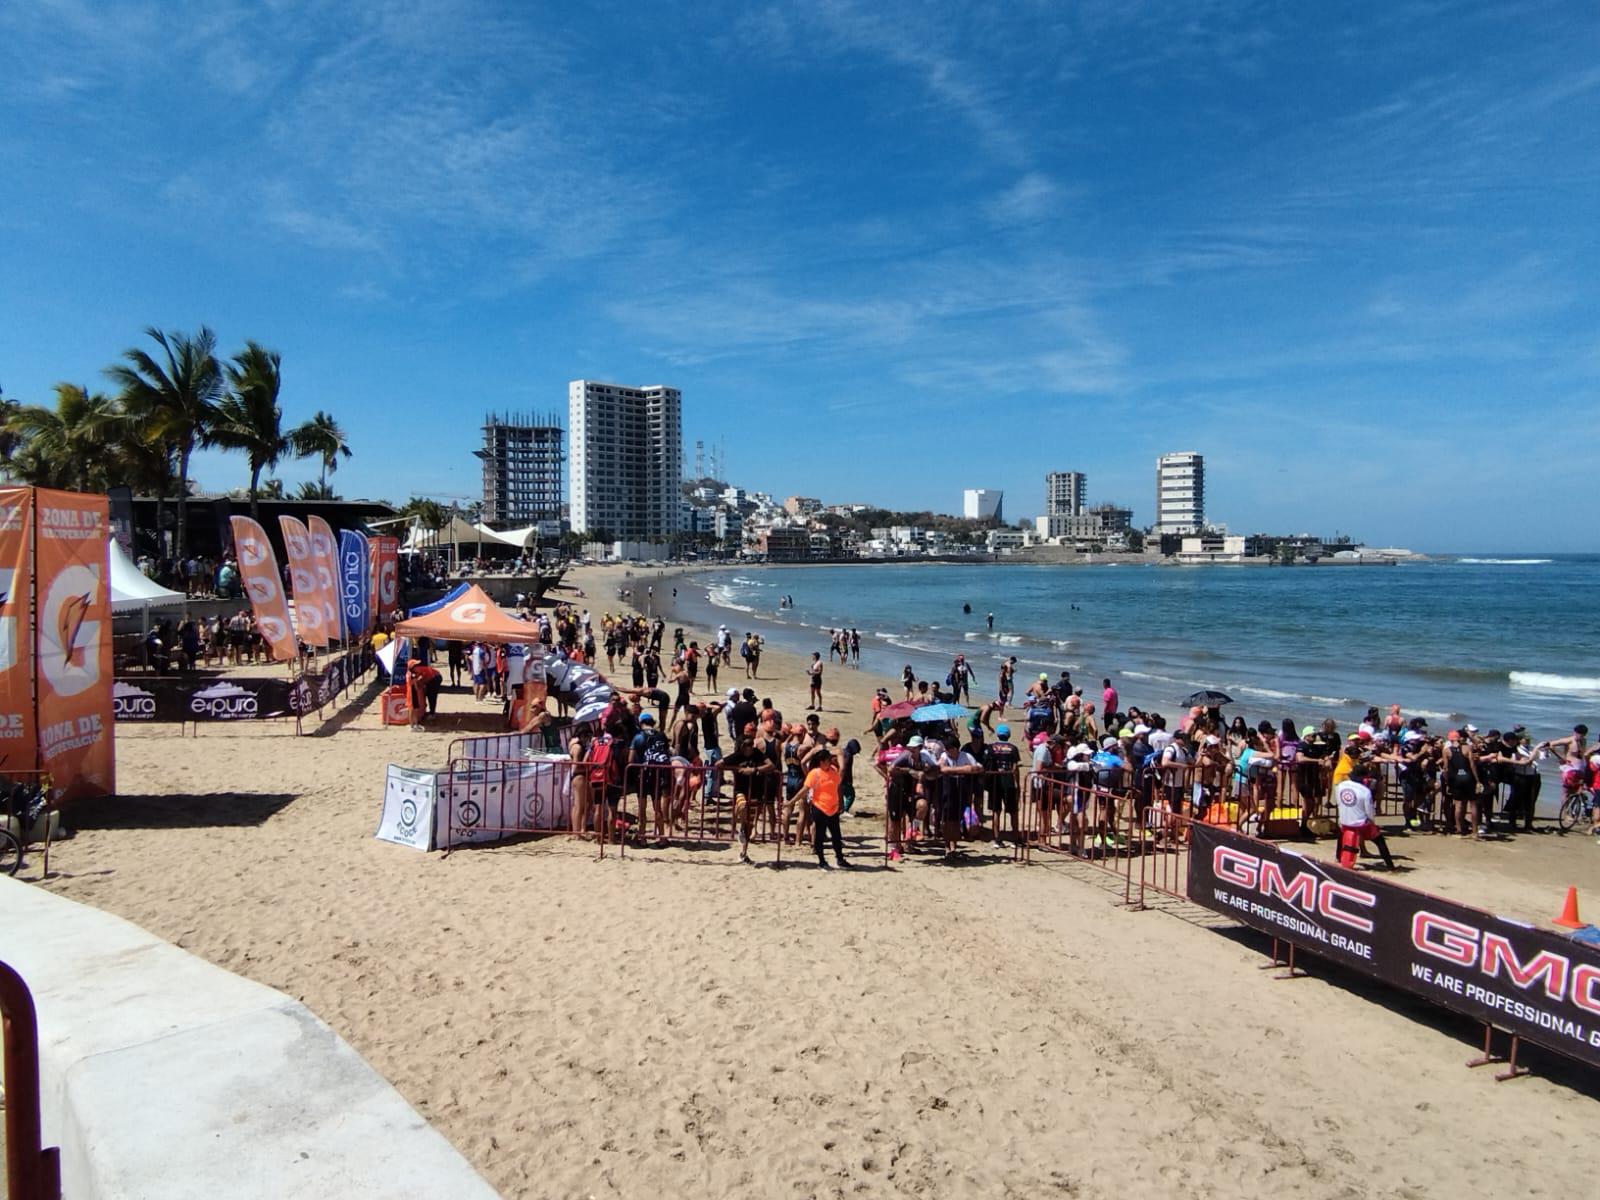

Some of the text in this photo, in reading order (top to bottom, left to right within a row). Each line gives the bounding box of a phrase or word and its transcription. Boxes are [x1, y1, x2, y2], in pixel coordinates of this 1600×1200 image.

[1213, 845, 1376, 934] GMC
[1214, 888, 1373, 960] WE ARE PROFESSIONAL GRADE
[1411, 962, 1432, 983] WE
[1434, 972, 1463, 995] ARE
[1465, 983, 1586, 1042] PROFESSIONAL
